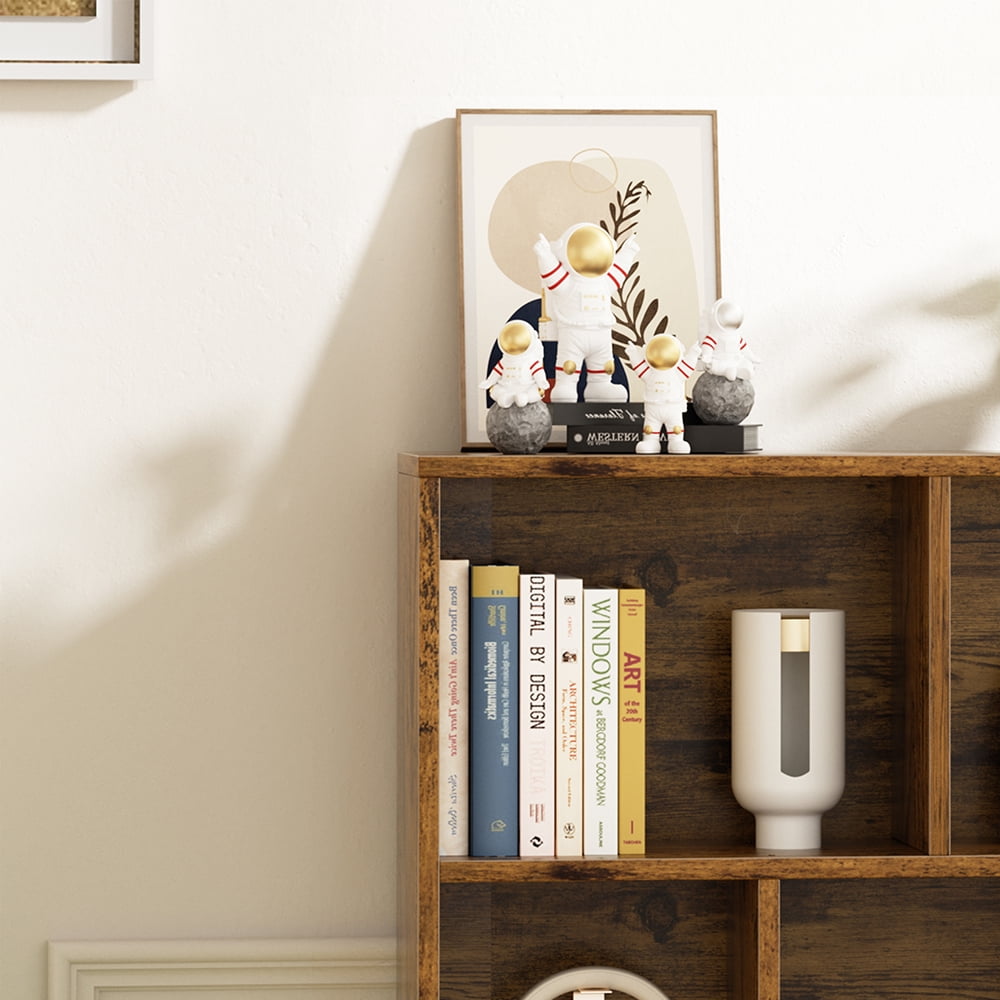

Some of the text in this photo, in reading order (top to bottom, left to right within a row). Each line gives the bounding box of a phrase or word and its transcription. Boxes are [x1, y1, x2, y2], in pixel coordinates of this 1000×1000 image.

[530, 576, 546, 730] DIGITAL BY DESIGN
[592, 598, 611, 706] WINDOWS
[624, 652, 641, 693] ART
[569, 680, 578, 761] ARCHITECTURE
[596, 718, 606, 761] BERGDORF
[596, 762, 606, 807] GOODMAN
